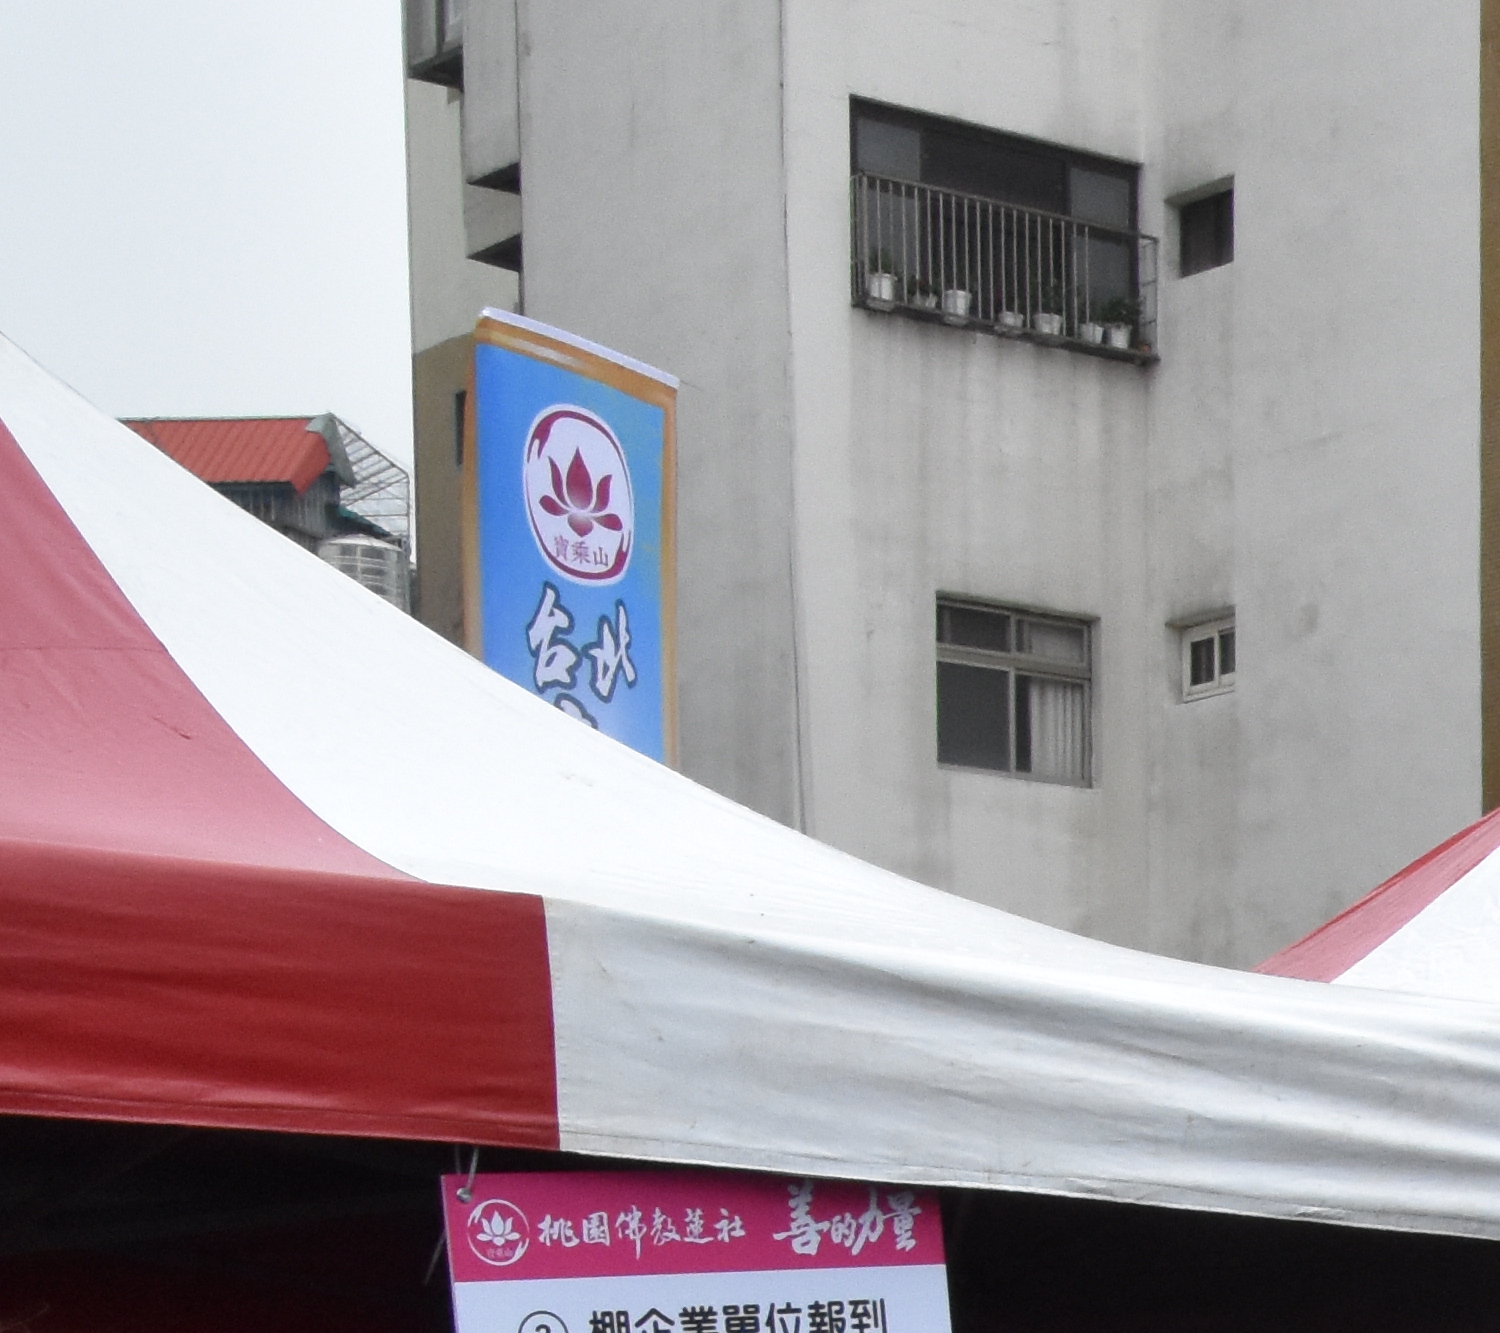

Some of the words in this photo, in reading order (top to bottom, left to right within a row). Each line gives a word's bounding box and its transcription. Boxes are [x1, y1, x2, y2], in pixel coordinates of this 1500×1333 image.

[537, 1204, 747, 1260] 桃園佛教蓮社
